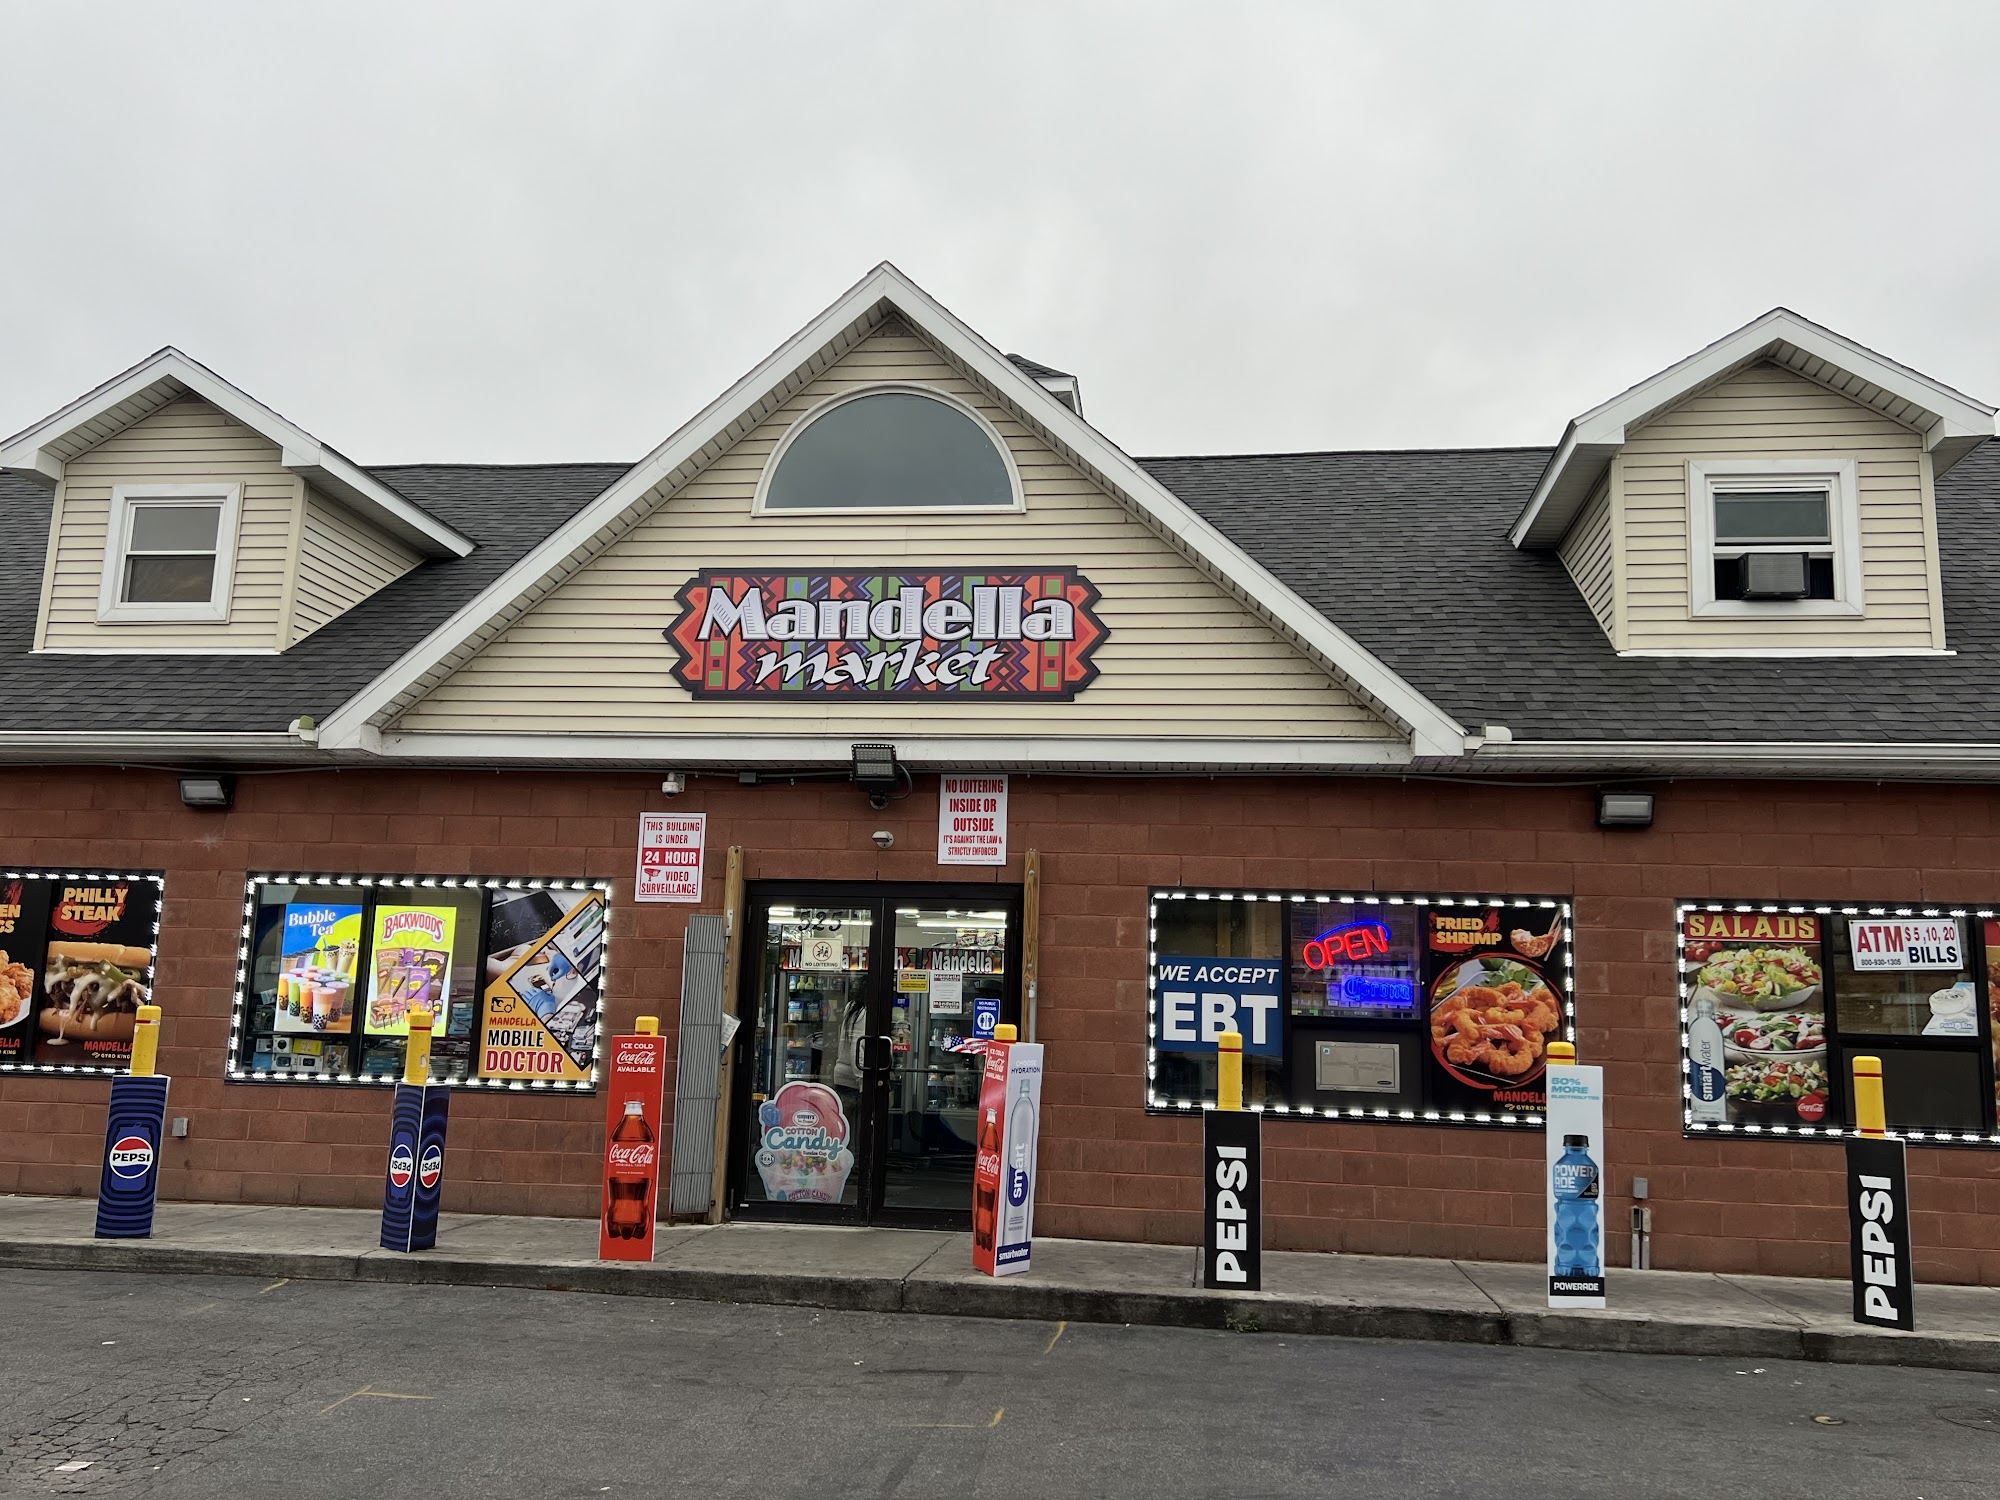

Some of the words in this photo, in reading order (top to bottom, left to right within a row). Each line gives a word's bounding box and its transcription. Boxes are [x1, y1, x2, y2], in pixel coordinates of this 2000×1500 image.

[697, 586, 1075, 640] Mandella
[755, 640, 1005, 685] market
[946, 780, 957, 793] NO
[960, 780, 1004, 793] LOITERING
[950, 799, 981, 812] INSIDE
[984, 799, 996, 812] OR
[646, 822, 663, 831] THIS
[666, 822, 700, 831] BUILDING
[954, 818, 994, 831] OUTSIDE
[656, 835, 662, 843] IS
[666, 835, 688, 844] UNDER
[944, 835, 953, 843] IT'S
[954, 835, 975, 844] AGAINST
[976, 835, 985, 844] THE
[987, 835, 998, 844] LAW
[644, 851, 660, 863] 24
[665, 851, 696, 864] HOUR
[948, 847, 971, 855] STRICTLY
[972, 847, 998, 855] ENFORCED
[666, 871, 689, 881] VIDEO
[641, 883, 696, 893] SURVEILLANCE
[64, 888, 128, 903] PHILLY
[61, 906, 121, 921] STEAK
[288, 909, 336, 926] Bubble
[798, 910, 842, 931] 525
[310, 924, 334, 936] Tea
[384, 913, 443, 940] BACKWOODS
[1436, 918, 1484, 930] FRIED
[1689, 915, 1815, 938] SALADS
[1436, 932, 1502, 946] SHRIMP
[1857, 926, 1904, 952] ATM
[1943, 927, 1955, 941] 20
[1303, 925, 1389, 970] OPEN
[1908, 946, 1958, 963] BILLS
[932, 951, 992, 972] Mandella
[1159, 965, 1191, 981] WE
[1194, 966, 1279, 984] ACCEPT
[1344, 976, 1410, 1001] Corona
[489, 1017, 536, 1026] MANDELLA
[1163, 992, 1278, 1044] EBT
[487, 1030, 544, 1047] MOBILE
[486, 1050, 564, 1074] DOCTOR
[616, 1050, 657, 1064] Coca-Cola
[987, 1056, 1005, 1072] Coca-Cola
[1552, 1077, 1581, 1085] 50%
[1493, 1090, 1546, 1104] MANDELL
[1552, 1086, 1588, 1094] MORE
[1798, 1103, 1824, 1113] Coca-Cola
[767, 1128, 843, 1160] Candy
[112, 1152, 150, 1162] PEPSI
[609, 1144, 654, 1164] Coca-Cola
[392, 1160, 411, 1172] PEPSI
[422, 1160, 440, 1172] PEPSI
[978, 1150, 999, 1175] Coca-Cola
[1014, 1143, 1024, 1198] smart
[1555, 1165, 1594, 1177] POWER
[1555, 1177, 1576, 1189] ADE
[788, 1188, 810, 1200] COTTON
[811, 1190, 832, 1201] CANDY
[1216, 1146, 1248, 1283] PEPSI
[999, 1248, 1028, 1260] smartwater
[1858, 1174, 1898, 1320] PEPSI
[1554, 1282, 1599, 1291] POWERADE
